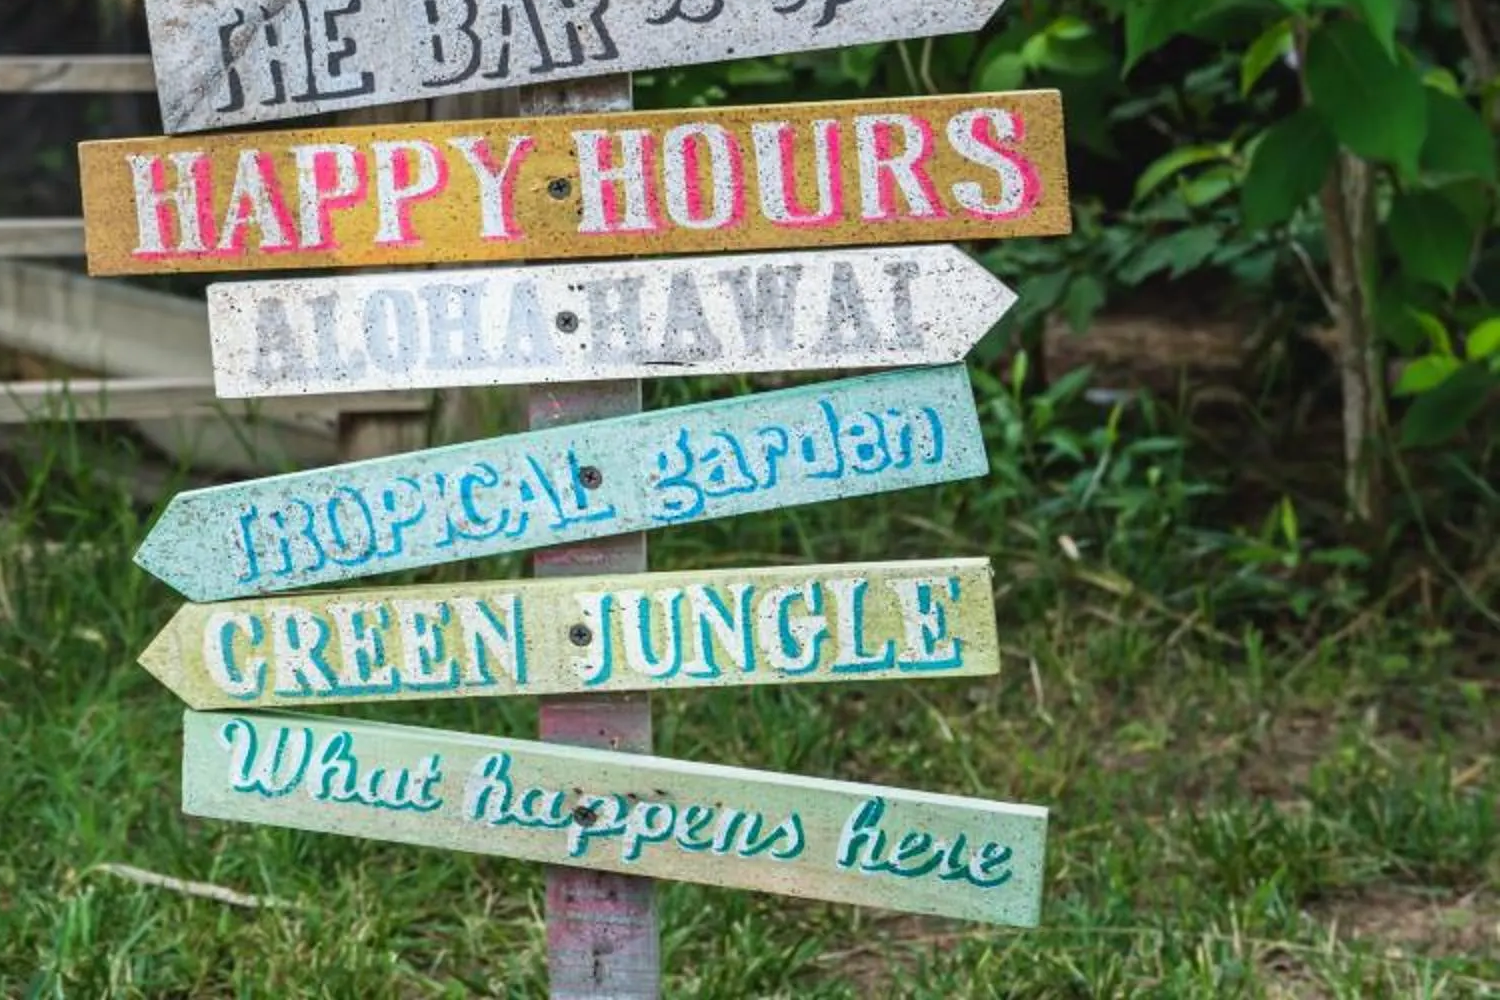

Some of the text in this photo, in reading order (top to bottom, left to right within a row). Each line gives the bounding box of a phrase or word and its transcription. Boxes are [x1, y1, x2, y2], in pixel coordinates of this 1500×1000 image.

[124, 106, 1045, 262] HAPPY HOURS
[246, 259, 926, 388] ALOHA HAWAI
[232, 400, 945, 584] TROPICAL garden
[576, 576, 964, 687] JUNGLE
[220, 717, 1014, 888] What happens here
